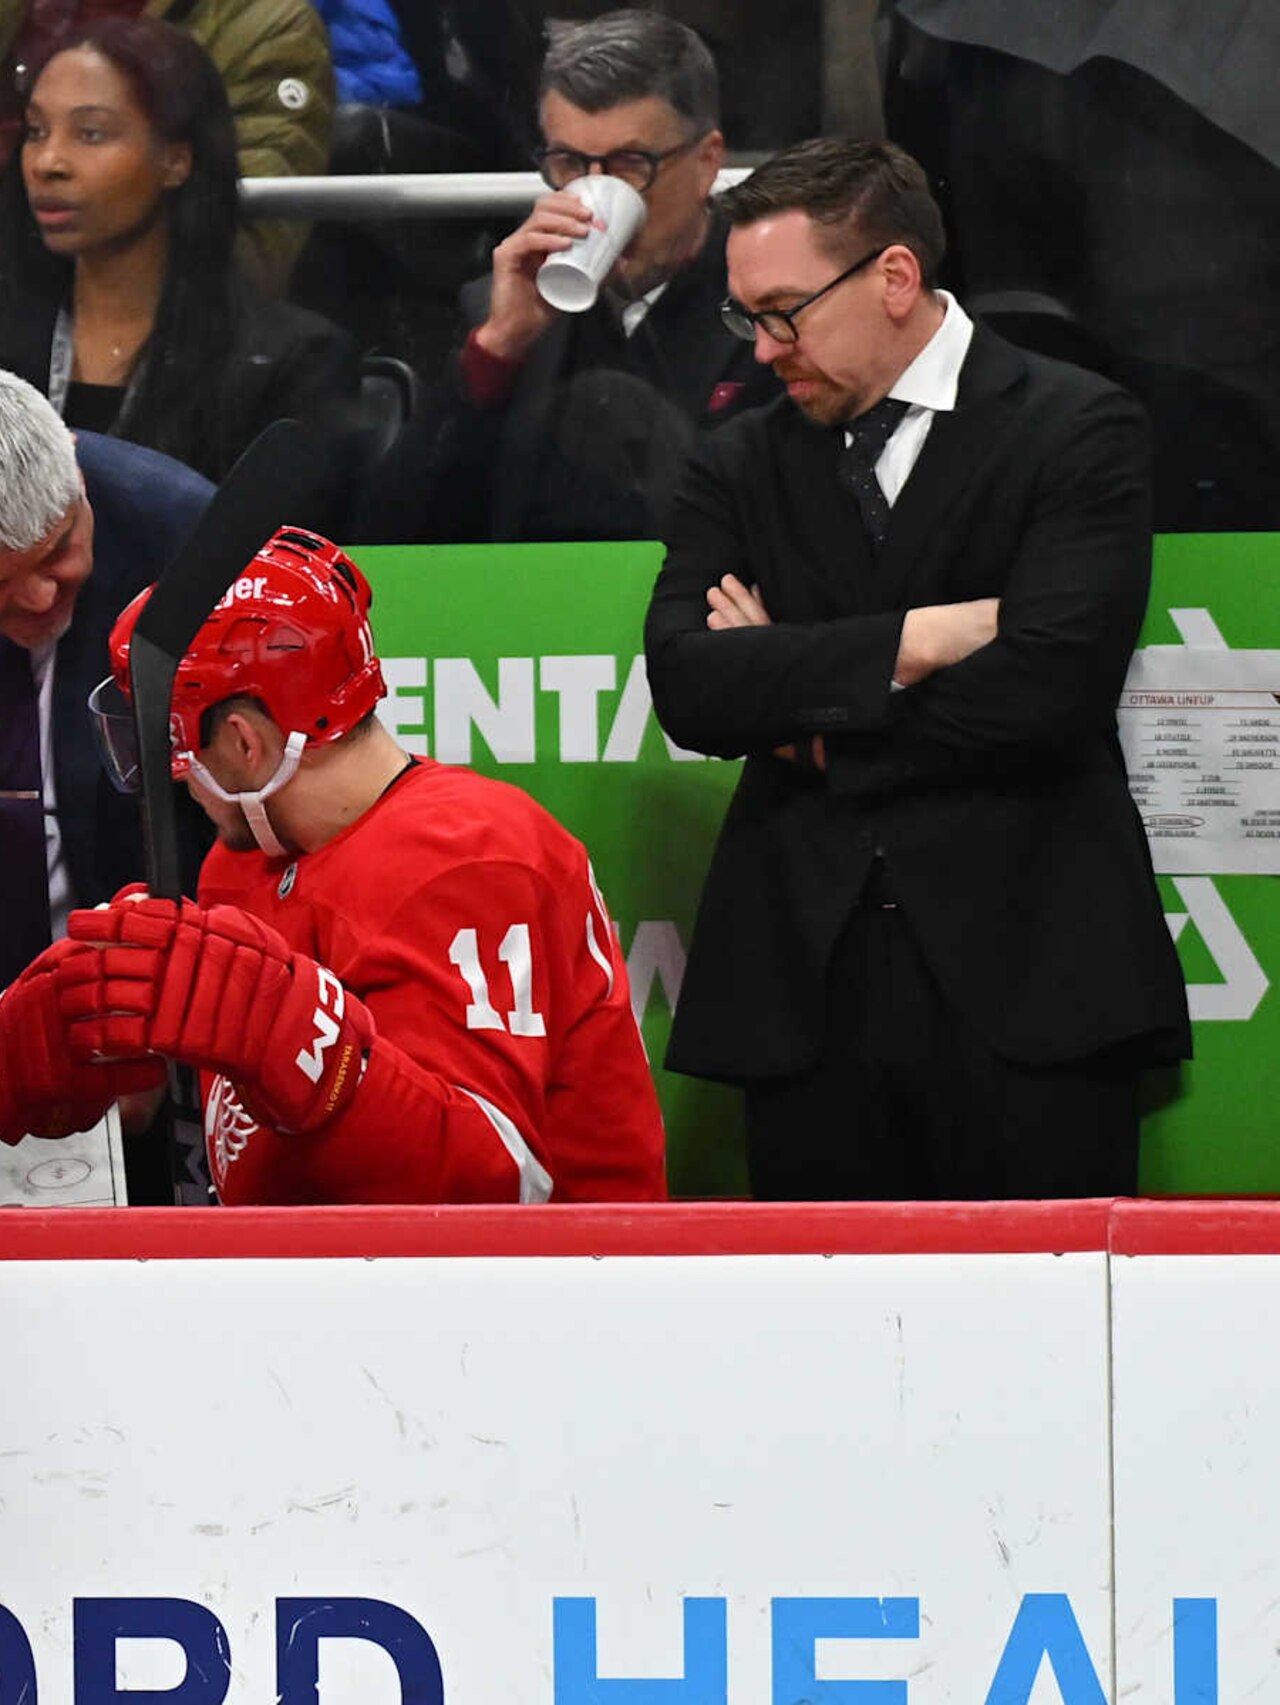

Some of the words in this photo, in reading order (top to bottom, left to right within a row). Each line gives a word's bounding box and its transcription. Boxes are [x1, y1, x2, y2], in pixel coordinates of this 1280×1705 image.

[1128, 695, 1175, 706] OTTAWA
[1176, 695, 1215, 706] LINEUP
[295, 966, 345, 1085] CM
[448, 923, 547, 1038] 11
